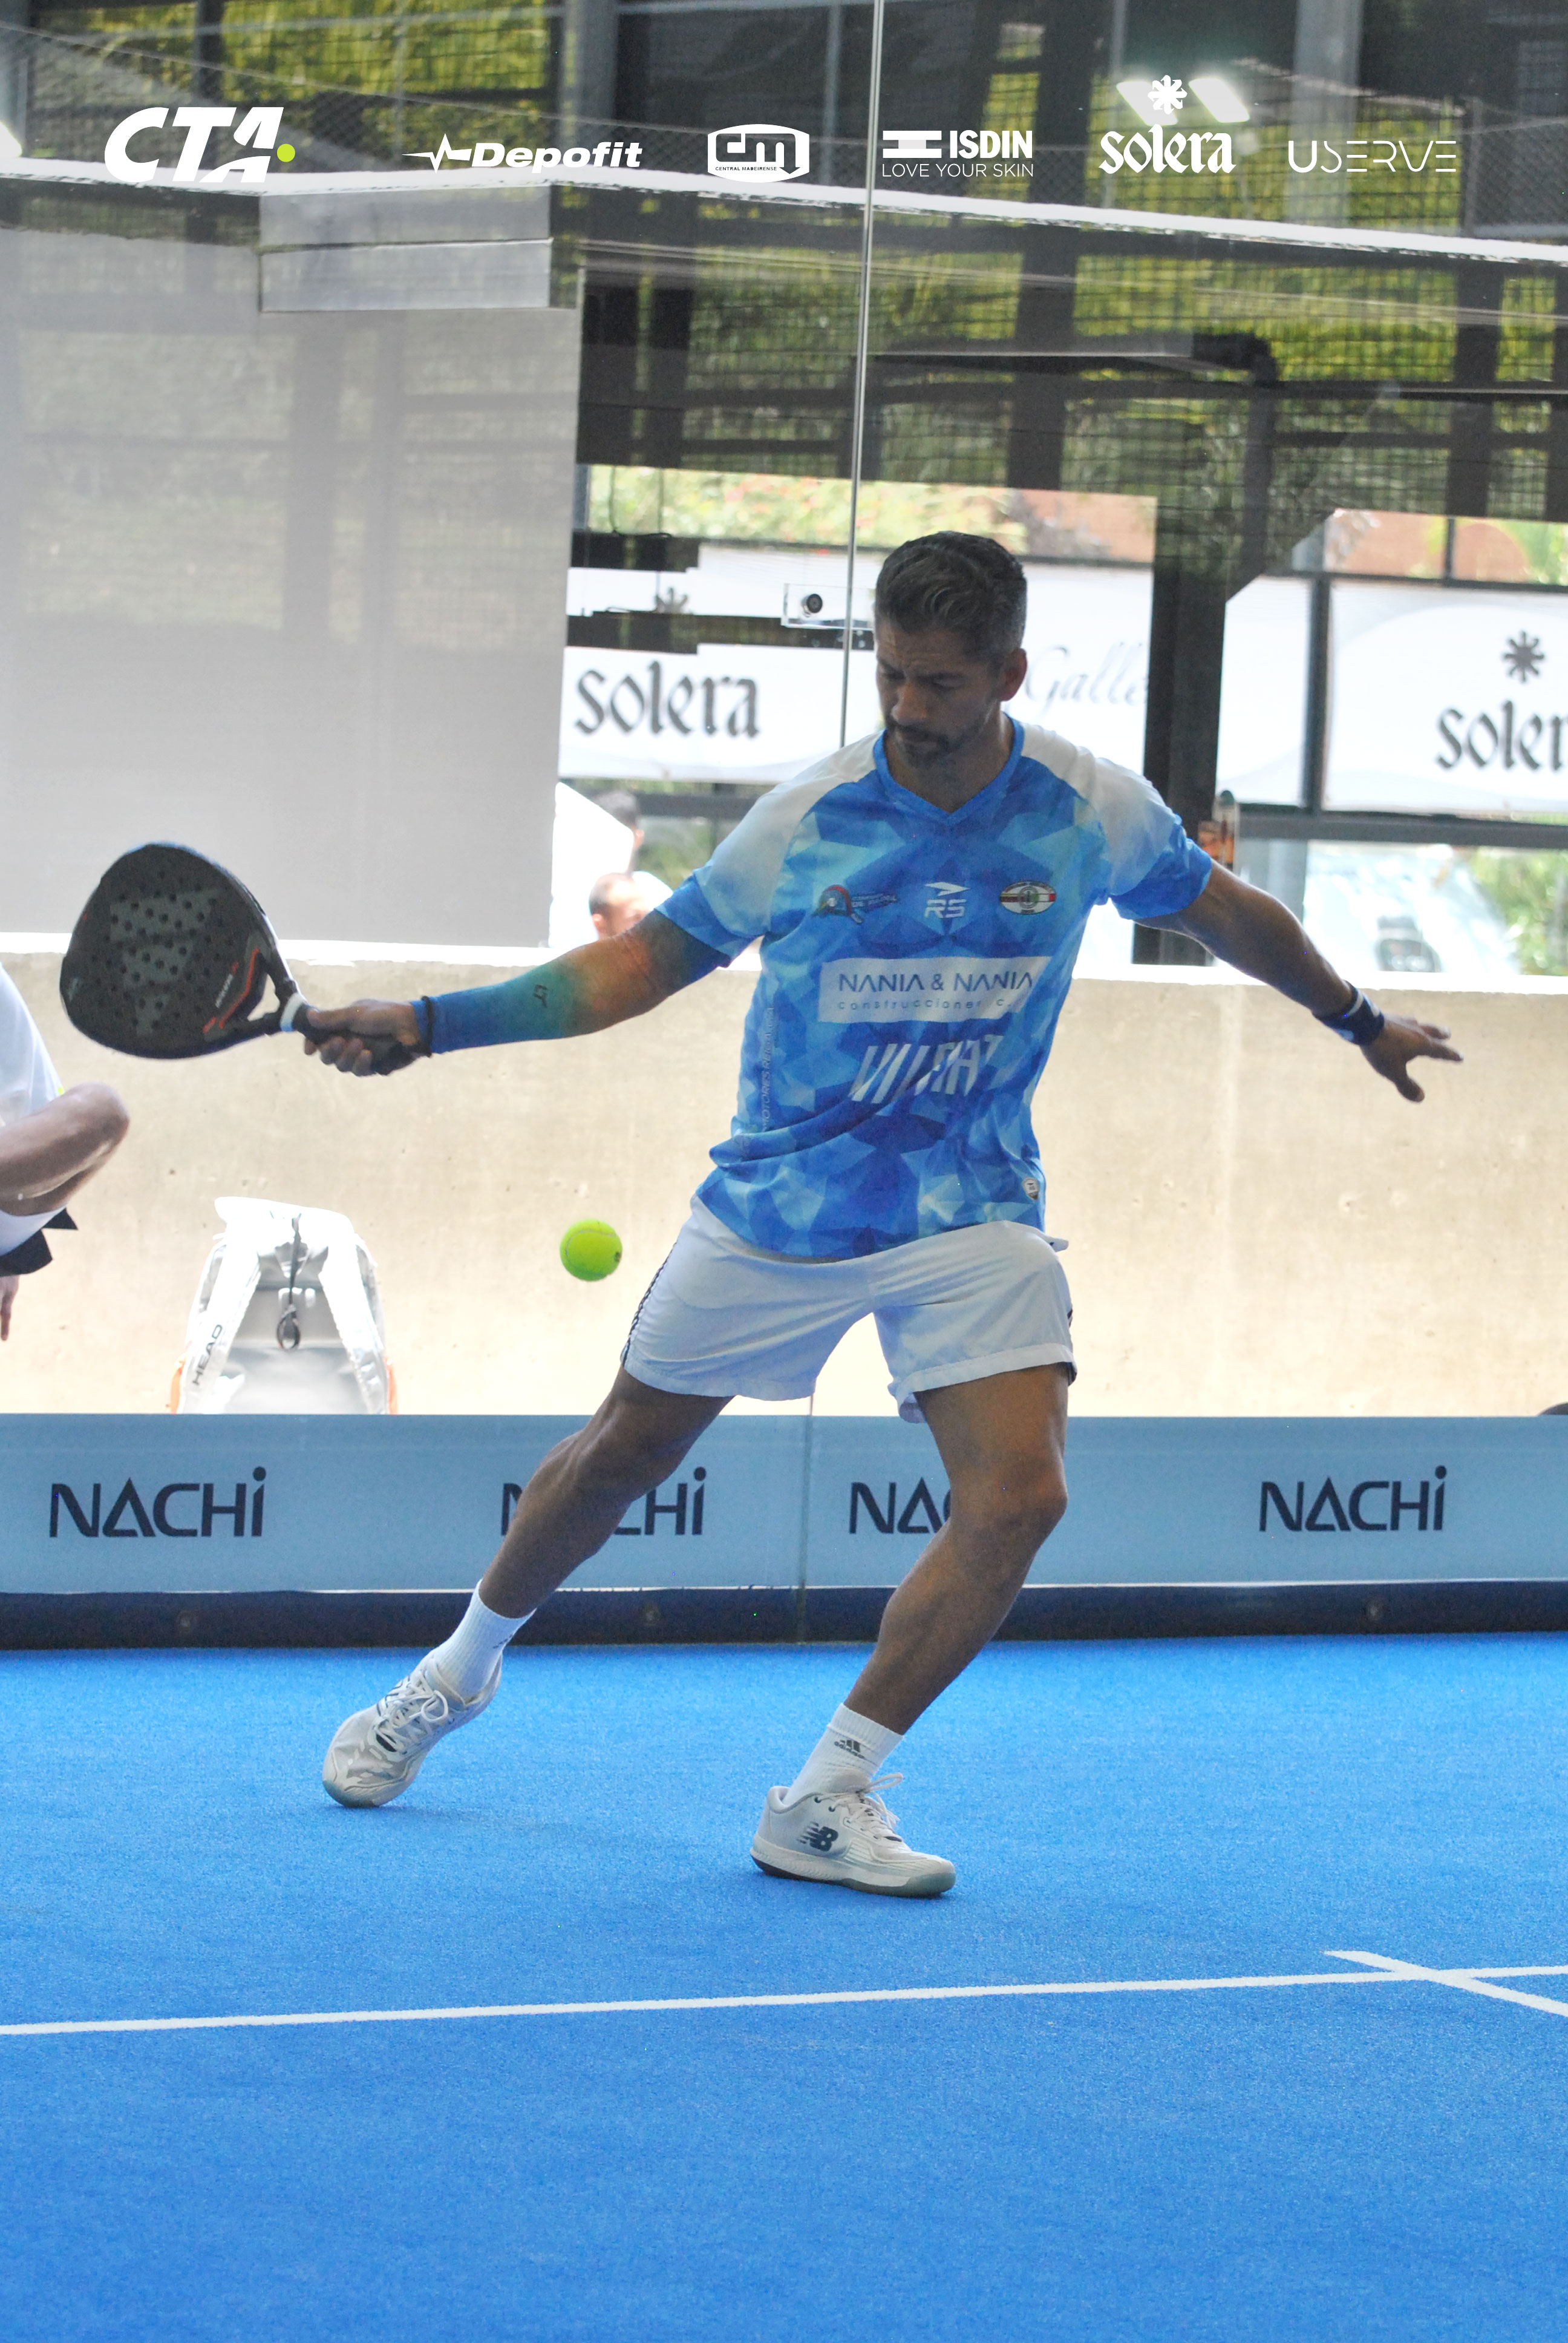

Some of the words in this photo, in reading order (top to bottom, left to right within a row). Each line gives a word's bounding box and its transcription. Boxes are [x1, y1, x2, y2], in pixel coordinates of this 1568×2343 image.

[575, 660, 761, 738] solera
[1024, 642, 1148, 721] Galle
[839, 972, 925, 992] NANIA
[930, 973, 945, 991] &
[953, 971, 1033, 992] NANIA
[192, 1324, 223, 1386] HEAD
[849, 1476, 952, 1535] NA
